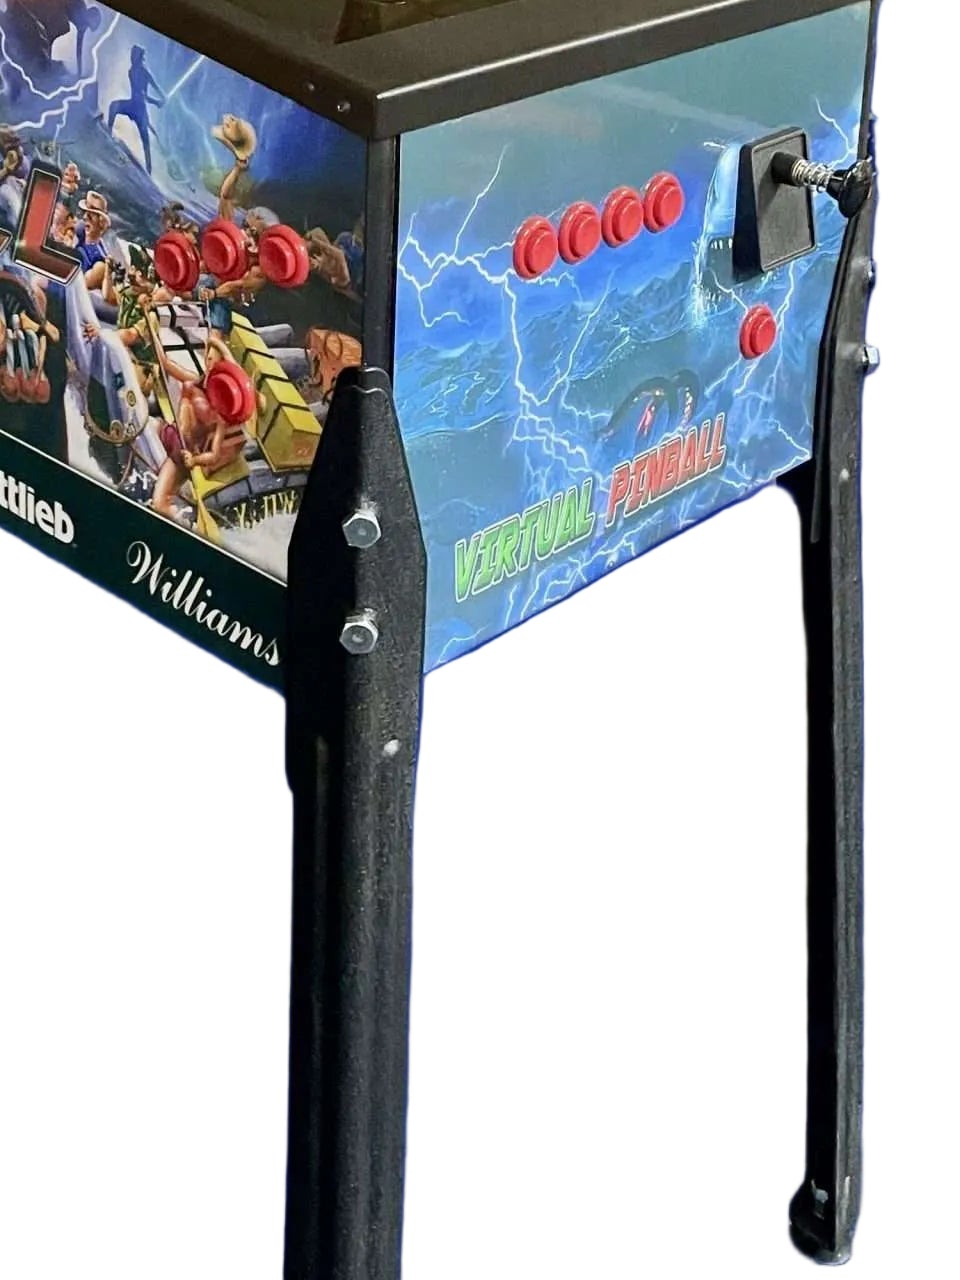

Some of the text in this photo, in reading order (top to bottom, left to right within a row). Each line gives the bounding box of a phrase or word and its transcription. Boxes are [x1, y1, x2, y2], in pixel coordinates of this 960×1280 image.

[453, 412, 727, 604] VIRTUAL PINBALL
[125, 540, 282, 668] Williams
